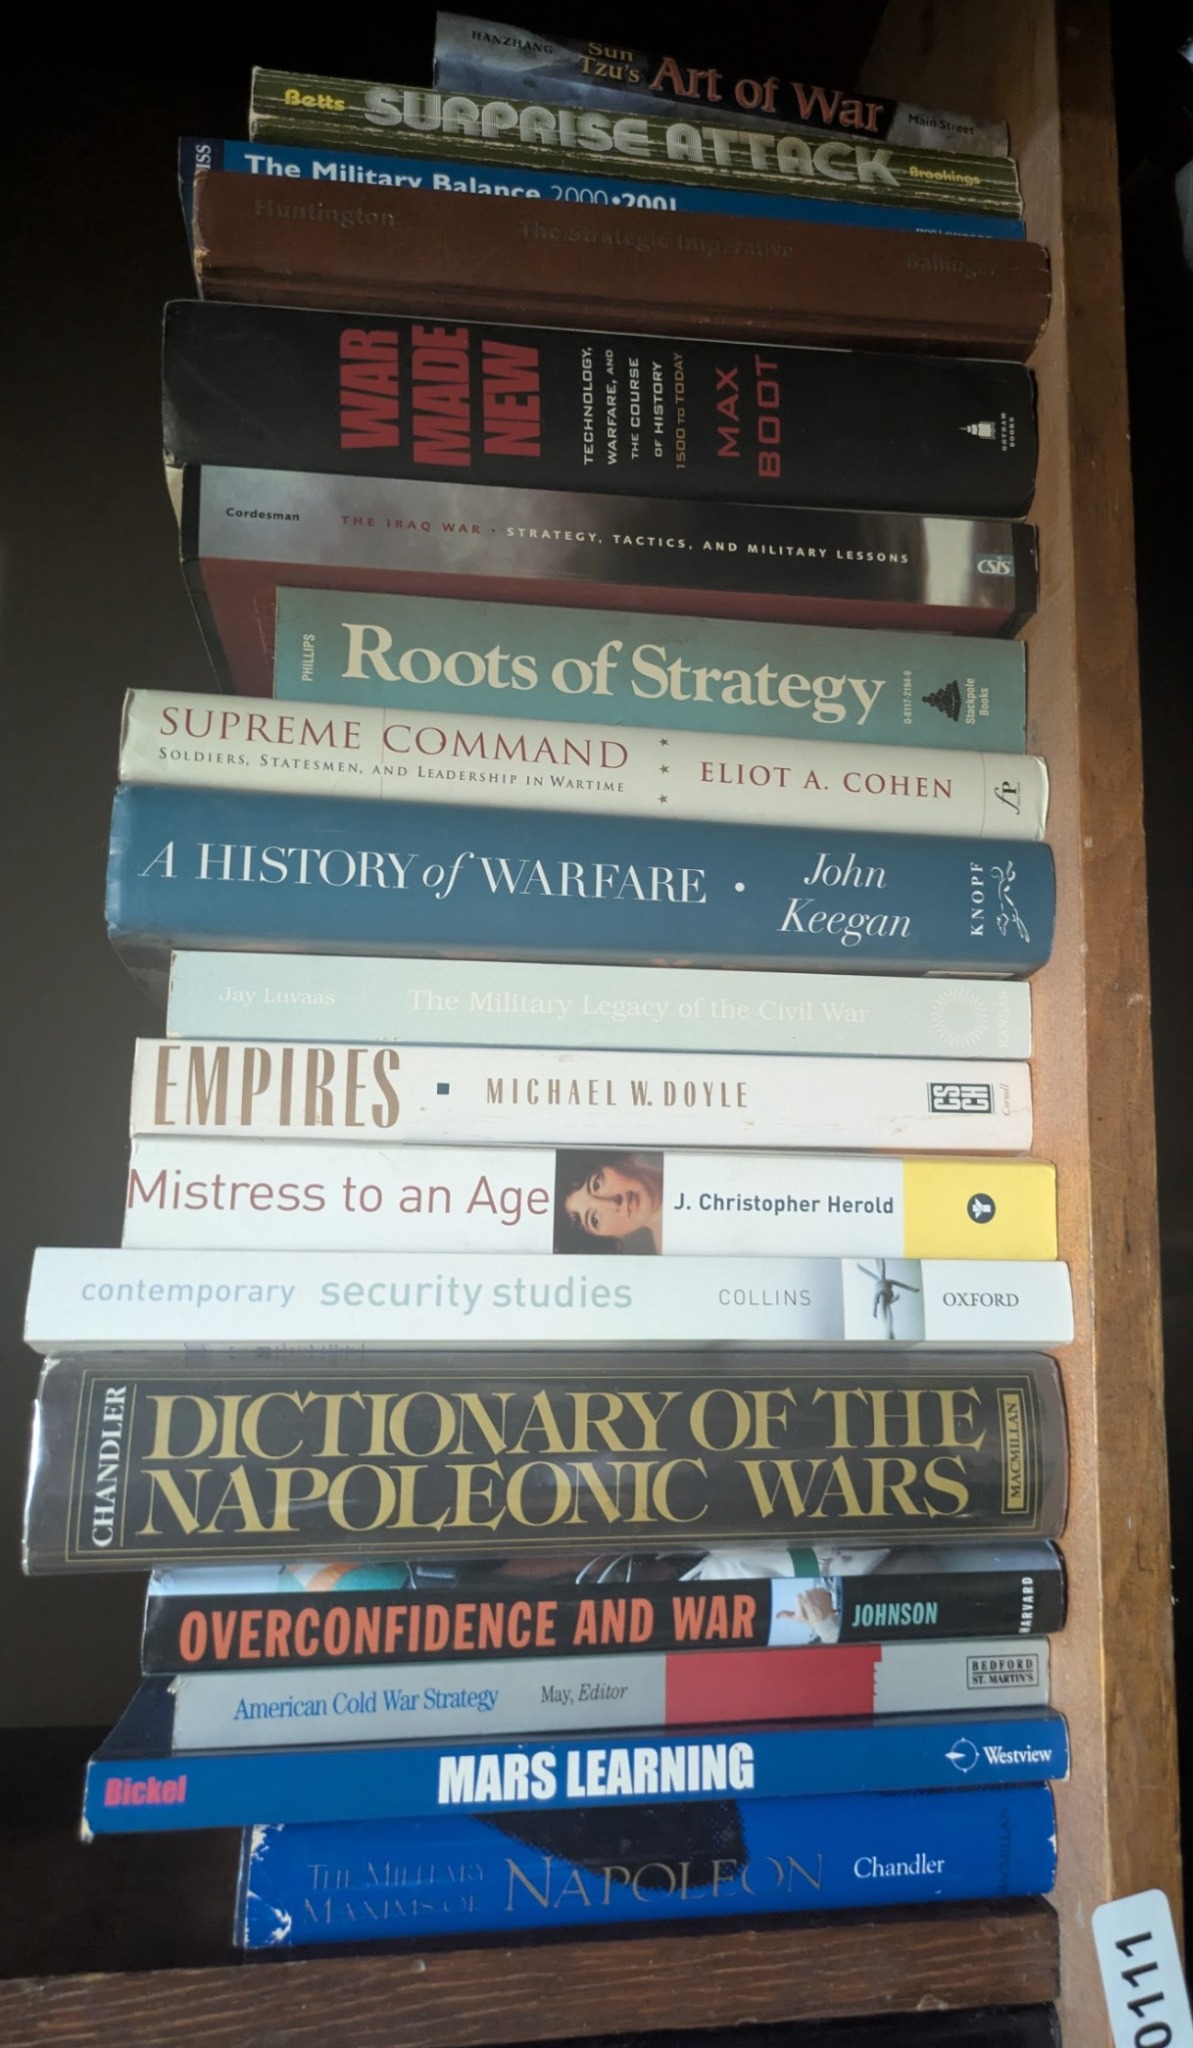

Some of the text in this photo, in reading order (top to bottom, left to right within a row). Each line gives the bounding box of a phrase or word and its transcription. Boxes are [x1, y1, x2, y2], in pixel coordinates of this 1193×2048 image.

[471, 30, 553, 55] HANZHANG
[588, 42, 634, 63] Sun
[579, 54, 641, 84] Tzu's
[284, 88, 345, 112] Betts
[649, 56, 884, 133] Art of War
[364, 86, 900, 187] SURPRISE ATTACK
[908, 113, 975, 135] Main Street
[244, 154, 301, 178] The
[312, 161, 422, 188] Military
[433, 173, 541, 199] Balance
[908, 165, 982, 187] Brookings
[254, 198, 395, 228] Huntington
[518, 219, 560, 241] The
[678, 232, 795, 260] Imprative
[340, 328, 399, 448] WAR
[411, 324, 471, 467] MADE
[482, 340, 541, 457] NEW
[581, 346, 594, 466] TECHNOLOGY,
[605, 349, 619, 465] WARFARE, AND
[629, 356, 640, 460] THE COURSE
[652, 361, 664, 458] OF HISTORY
[673, 352, 686, 471] 1500 TO TODAY
[715, 365, 741, 458] MAX
[754, 354, 782, 478] BOOT
[226, 507, 300, 522] Cordesman
[341, 515, 909, 564] THE IRAQ WAR STRATEGY, TACTICS, AND MILITARY LESSONS
[302, 634, 316, 682] PHILLIPS
[341, 622, 886, 726] Roots of Strategy
[903, 671, 912, 724] 0-8117-2194-9
[965, 678, 976, 724] Stackpole
[979, 688, 989, 716] Books
[160, 706, 628, 769] SUPREME COMMAND
[700, 761, 954, 799] ELIOT A. COHEN
[137, 840, 707, 904] A HISTORY of WARFARE
[803, 852, 887, 889] John
[776, 897, 911, 947] Keegan
[969, 861, 985, 936] KNOPF
[218, 986, 335, 1006] Jay Luvaas
[407, 989, 870, 1023] The Military Legacy of the Civil War
[998, 989, 1010, 1048] KANSAS
[153, 1044, 400, 1129] EMPIRES
[486, 1078, 748, 1108] MICHAEL W. DOYLE
[127, 1168, 549, 1226] Mistress to an Age
[674, 1192, 894, 1216] J. Christopher Herold
[81, 1274, 632, 1315] contemporary security studies
[718, 1287, 811, 1306] COLLINS
[943, 1292, 1019, 1308] OXFORD
[141, 1387, 986, 1460] DICTIONARY OF THE
[91, 1385, 127, 1547] CHANDLER
[1008, 1401, 1023, 1499] MACMILLAN
[135, 1455, 970, 1537] NAPOLEONIC WARS
[179, 1595, 756, 1662] OVERCONFIDENCE AND WAR
[852, 1601, 938, 1628] JOHNSON
[1019, 1575, 1034, 1634] HARVARD
[972, 1659, 1033, 1672] BEDFORD
[972, 1671, 1034, 1685] ST. MARTIN'S
[233, 1687, 499, 1721] American Cold War Strategy
[541, 1682, 628, 1706] May, Editor
[437, 1742, 754, 1804] MARS LEARNING
[984, 1744, 1052, 1765] Westview
[104, 1775, 187, 1806] Bickel
[306, 1864, 352, 1890] TH
[504, 1853, 823, 1913] NAPOLEON
[854, 1853, 945, 1879] Chandler
[1115, 1931, 1172, 2048] 0111
